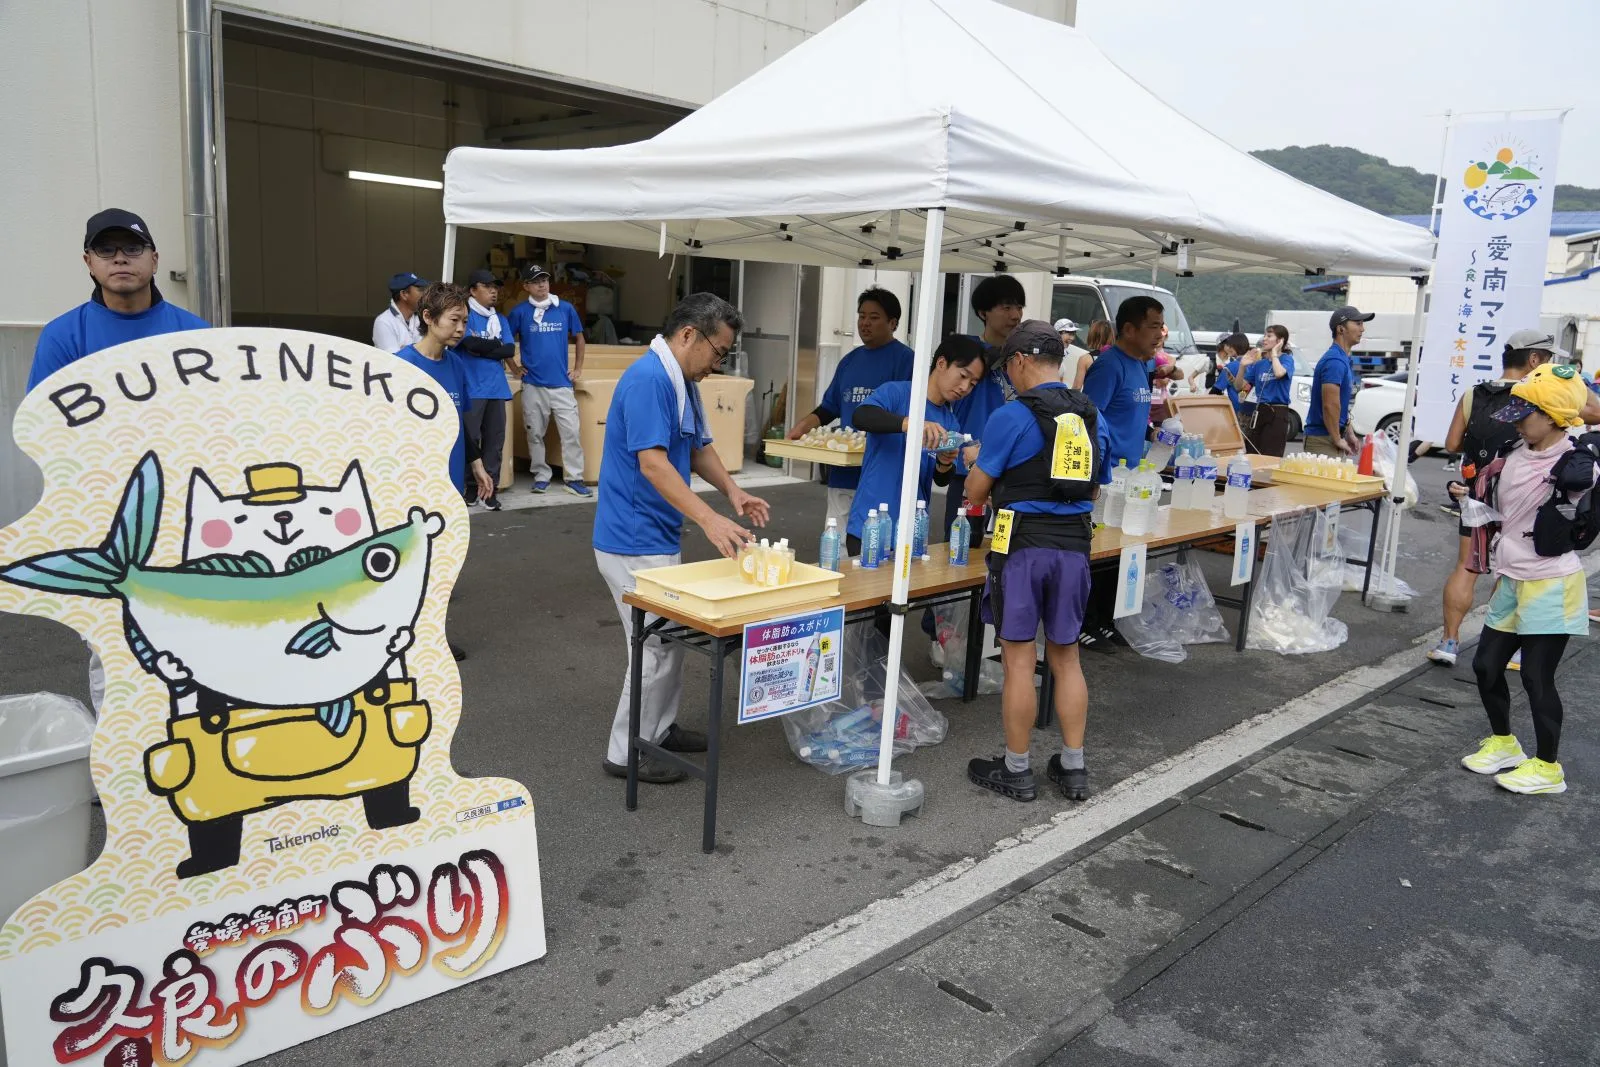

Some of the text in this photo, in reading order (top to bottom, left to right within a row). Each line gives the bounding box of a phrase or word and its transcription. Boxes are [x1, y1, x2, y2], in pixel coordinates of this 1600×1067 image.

[49, 342, 439, 427] BURINEKO
[762, 617, 830, 641] 体脂肪のスポドリ
[53, 852, 504, 1065] 久良のぶり
